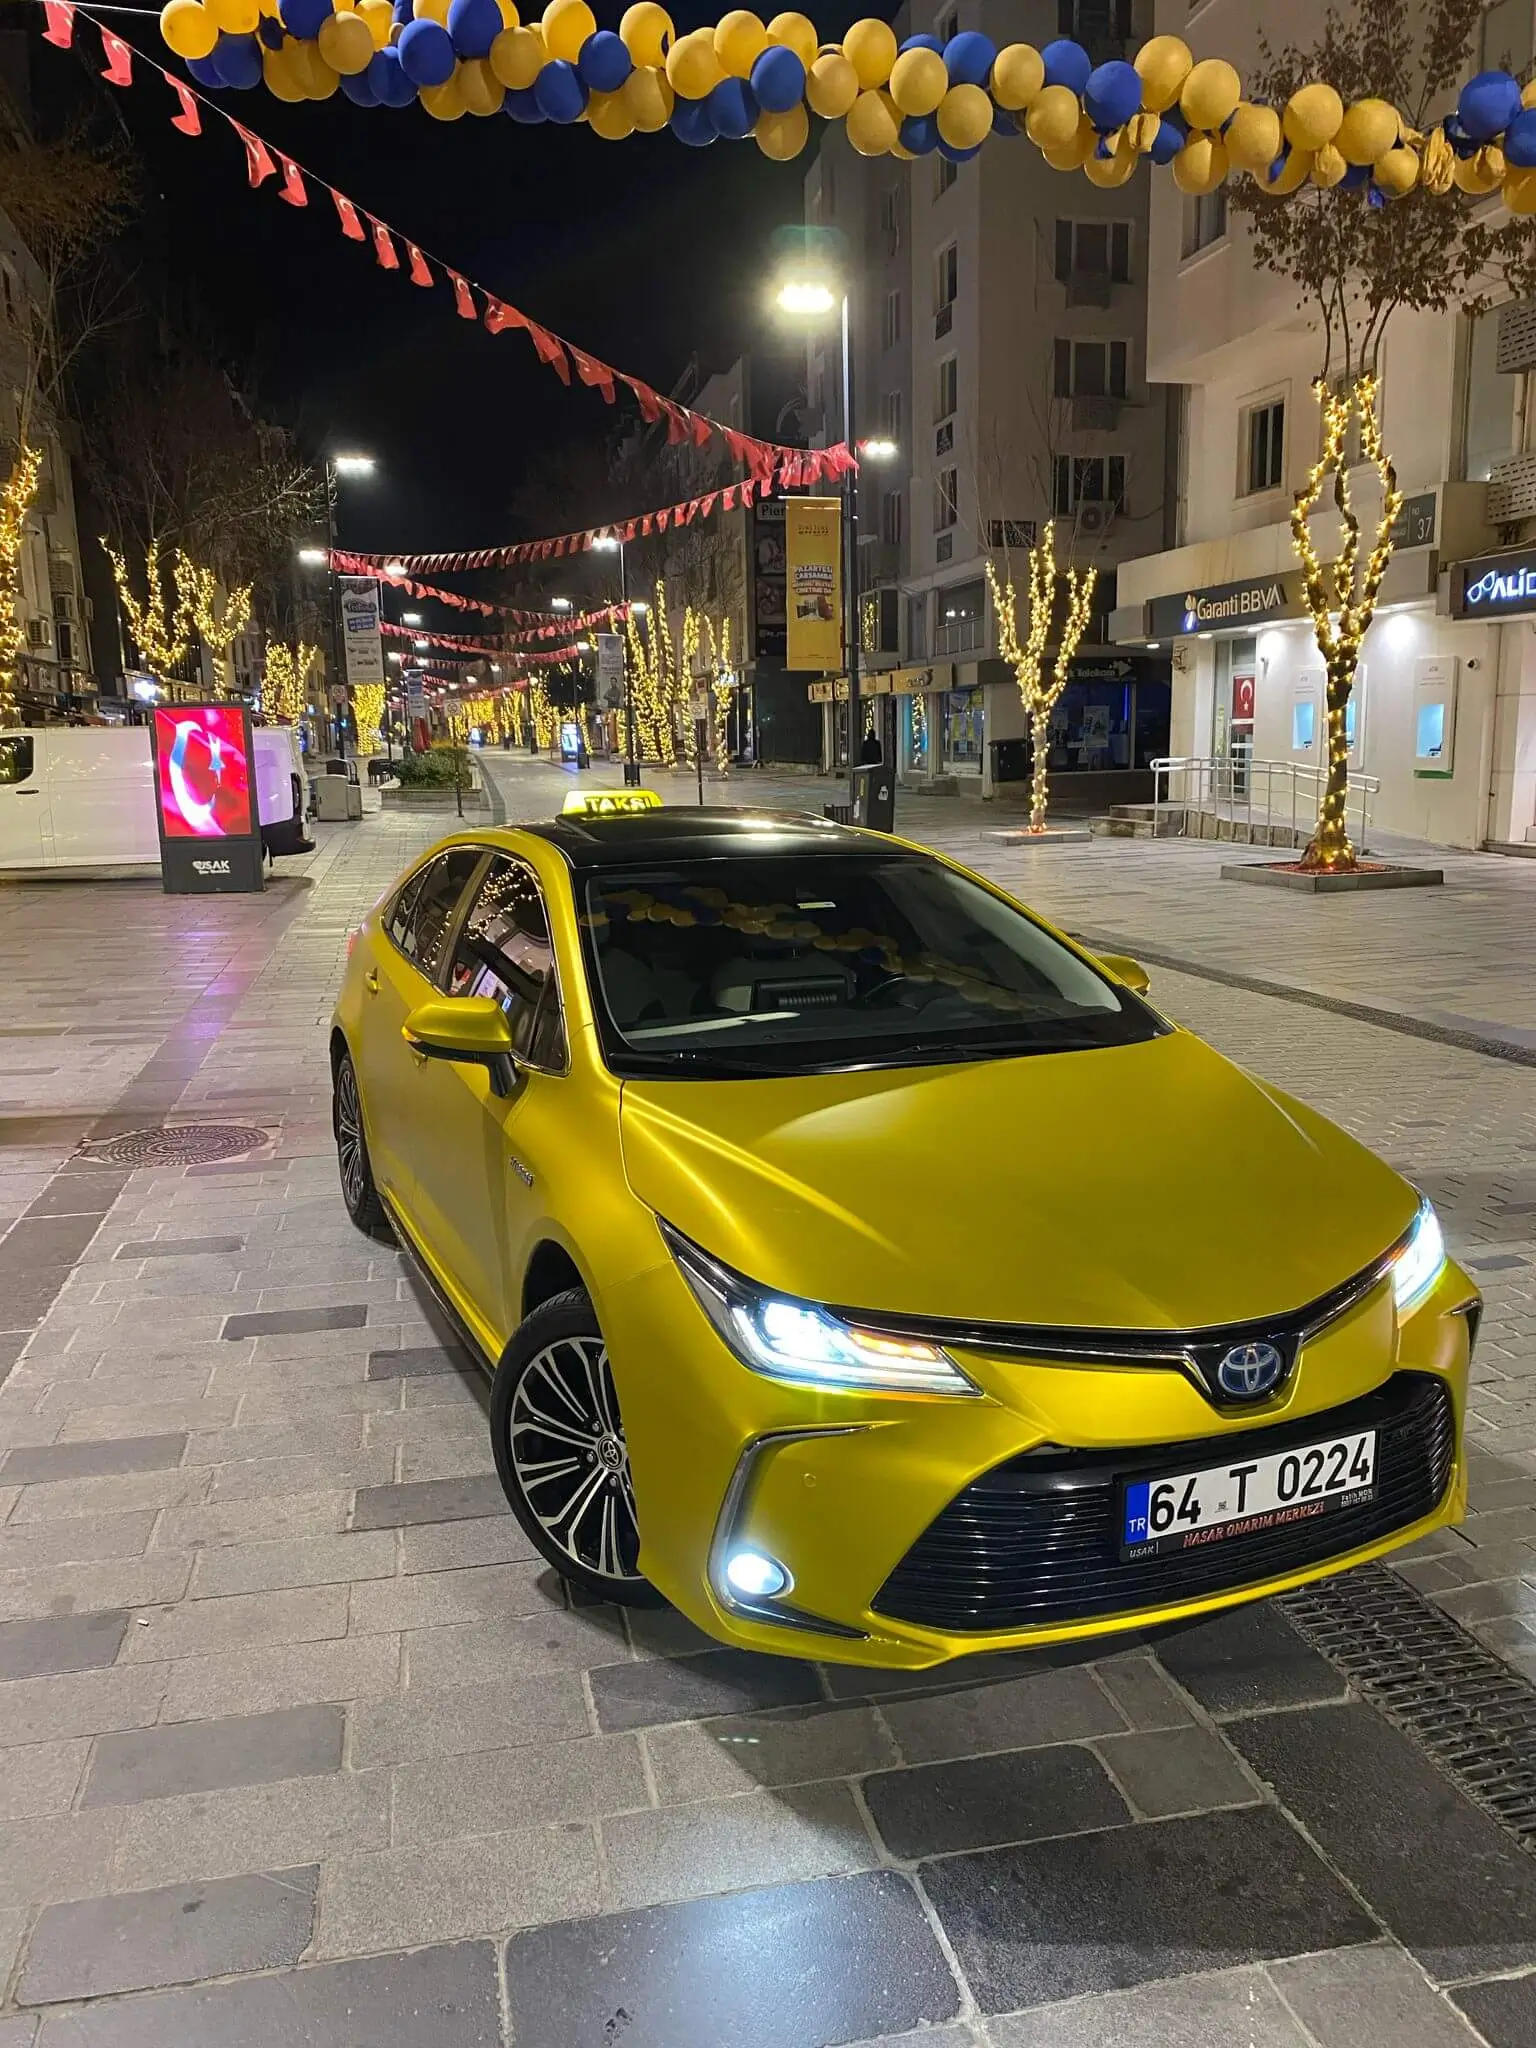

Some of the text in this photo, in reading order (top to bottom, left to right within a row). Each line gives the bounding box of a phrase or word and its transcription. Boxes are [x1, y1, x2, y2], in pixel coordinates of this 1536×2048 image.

[1417, 516, 1432, 540] 37
[1196, 583, 1281, 620] Garanti BBVA
[1149, 1437, 1370, 1532] 64 T 0224
[1128, 1517, 1146, 1533] TR
[1182, 1526, 1224, 1549] HASAR
[1226, 1514, 1274, 1538] ONARIM
